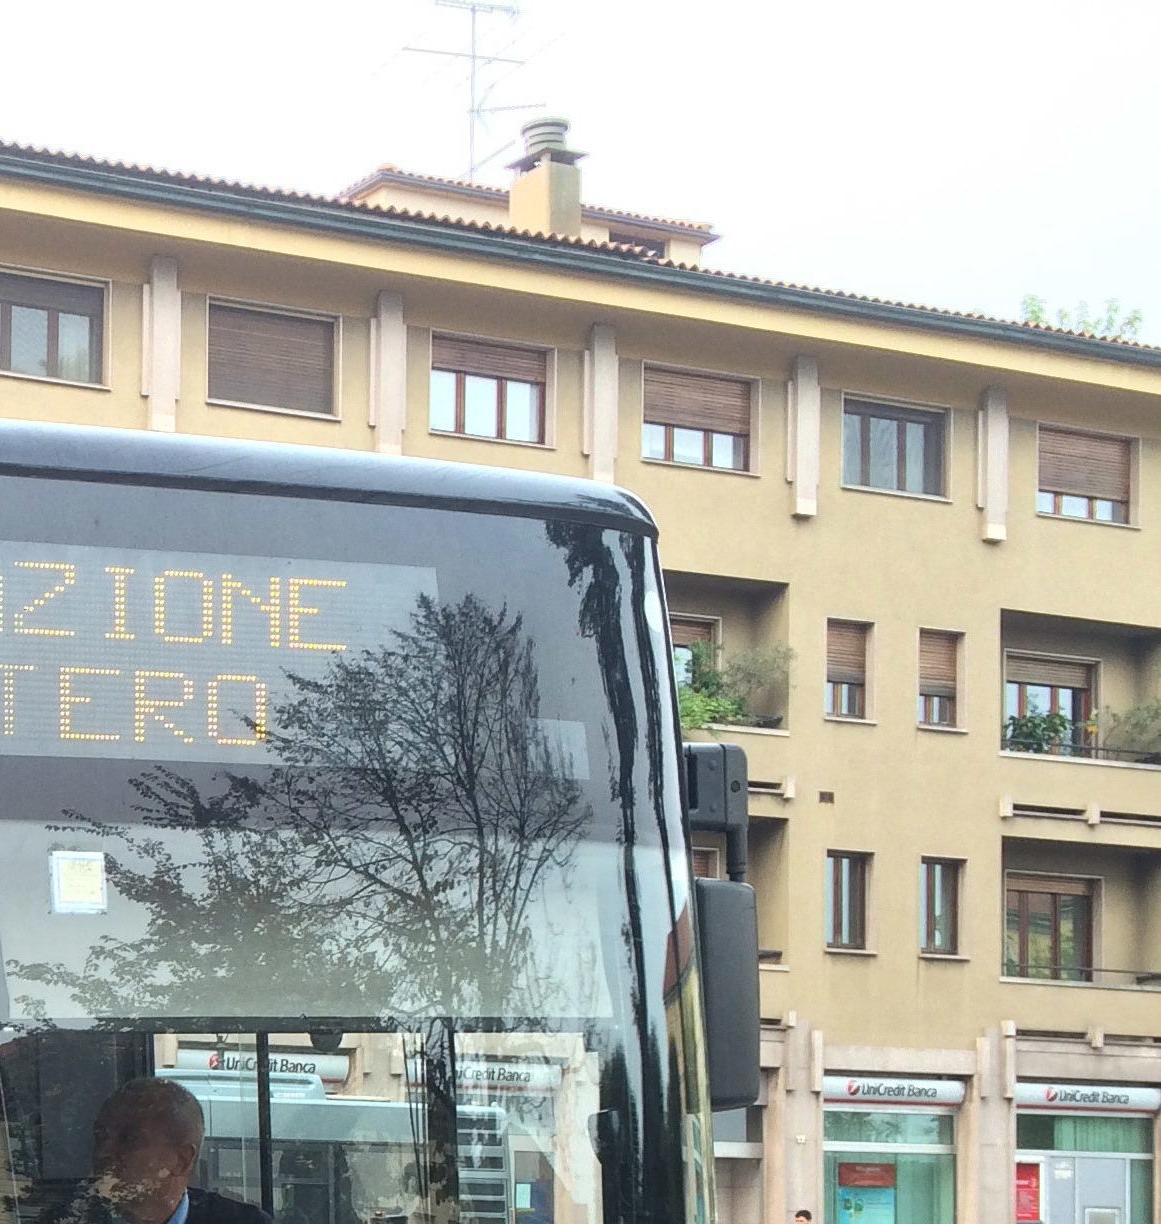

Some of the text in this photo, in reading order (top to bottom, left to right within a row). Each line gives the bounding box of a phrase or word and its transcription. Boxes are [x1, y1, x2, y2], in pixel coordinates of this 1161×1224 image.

[280, 1059, 316, 1073] Banca
[497, 1068, 531, 1082] Banca
[861, 1082, 938, 1098] UniCredit Banca
[1059, 1089, 1130, 1105] UniCredit Banca
